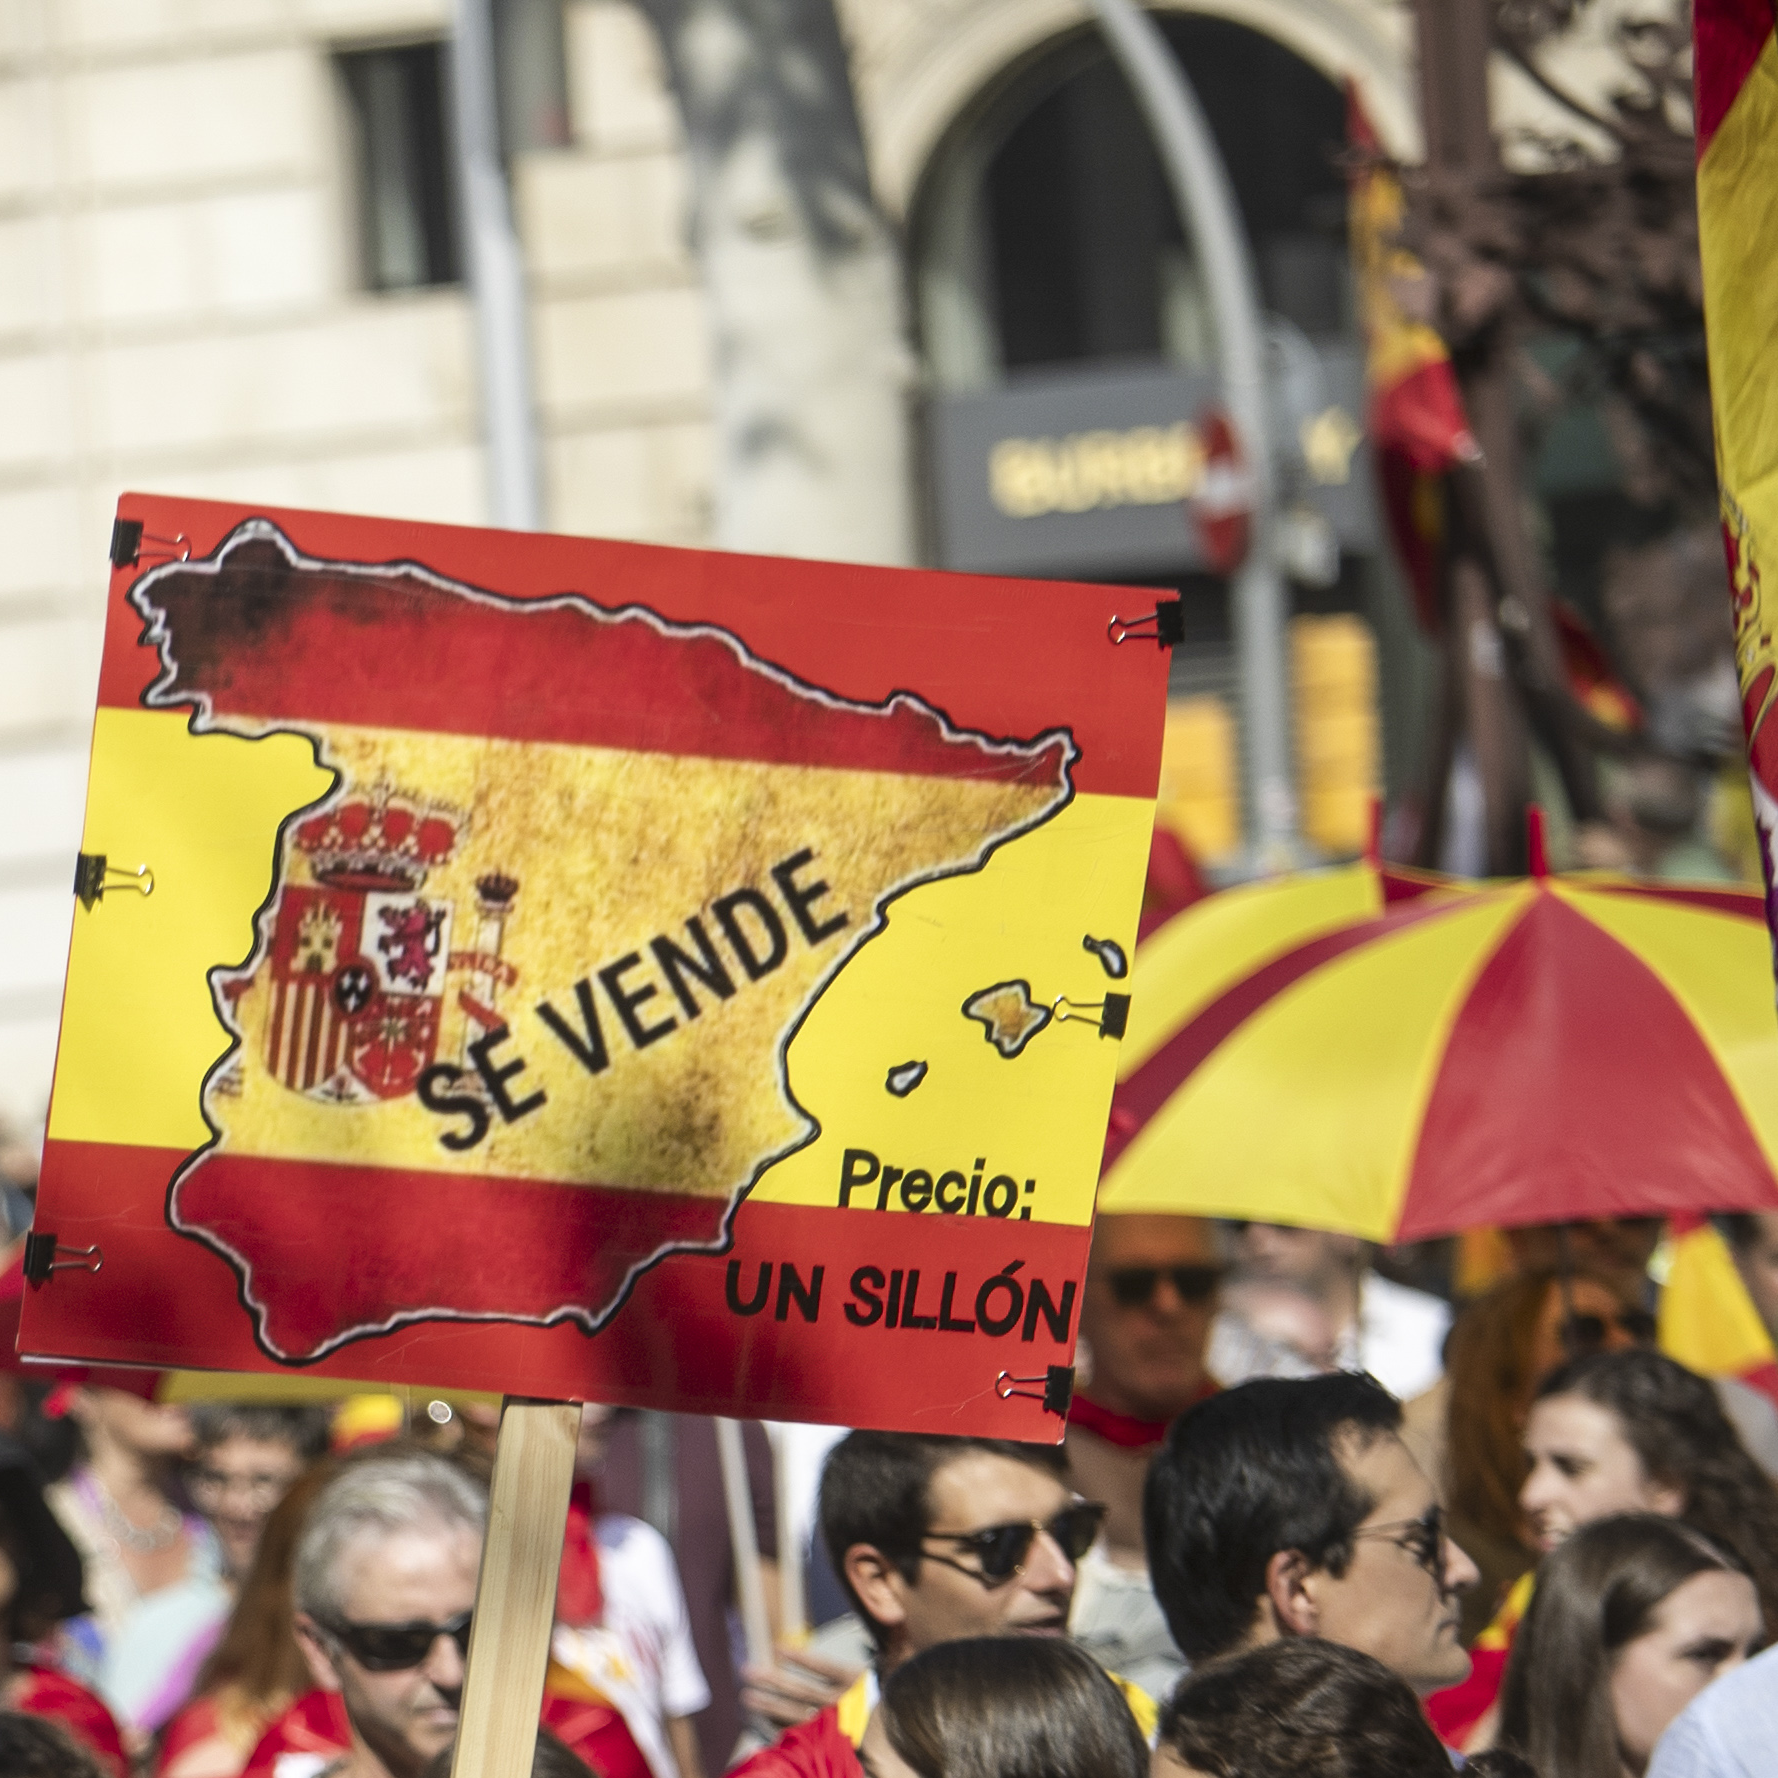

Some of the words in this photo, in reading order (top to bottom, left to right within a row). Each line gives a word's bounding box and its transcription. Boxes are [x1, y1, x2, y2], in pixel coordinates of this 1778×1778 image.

[416, 1022, 547, 1151] SE
[535, 846, 850, 1076] VENDE
[838, 1147, 1036, 1221] Precio:
[725, 1259, 825, 1322] UN
[843, 1259, 1078, 1344] SILLÓN
